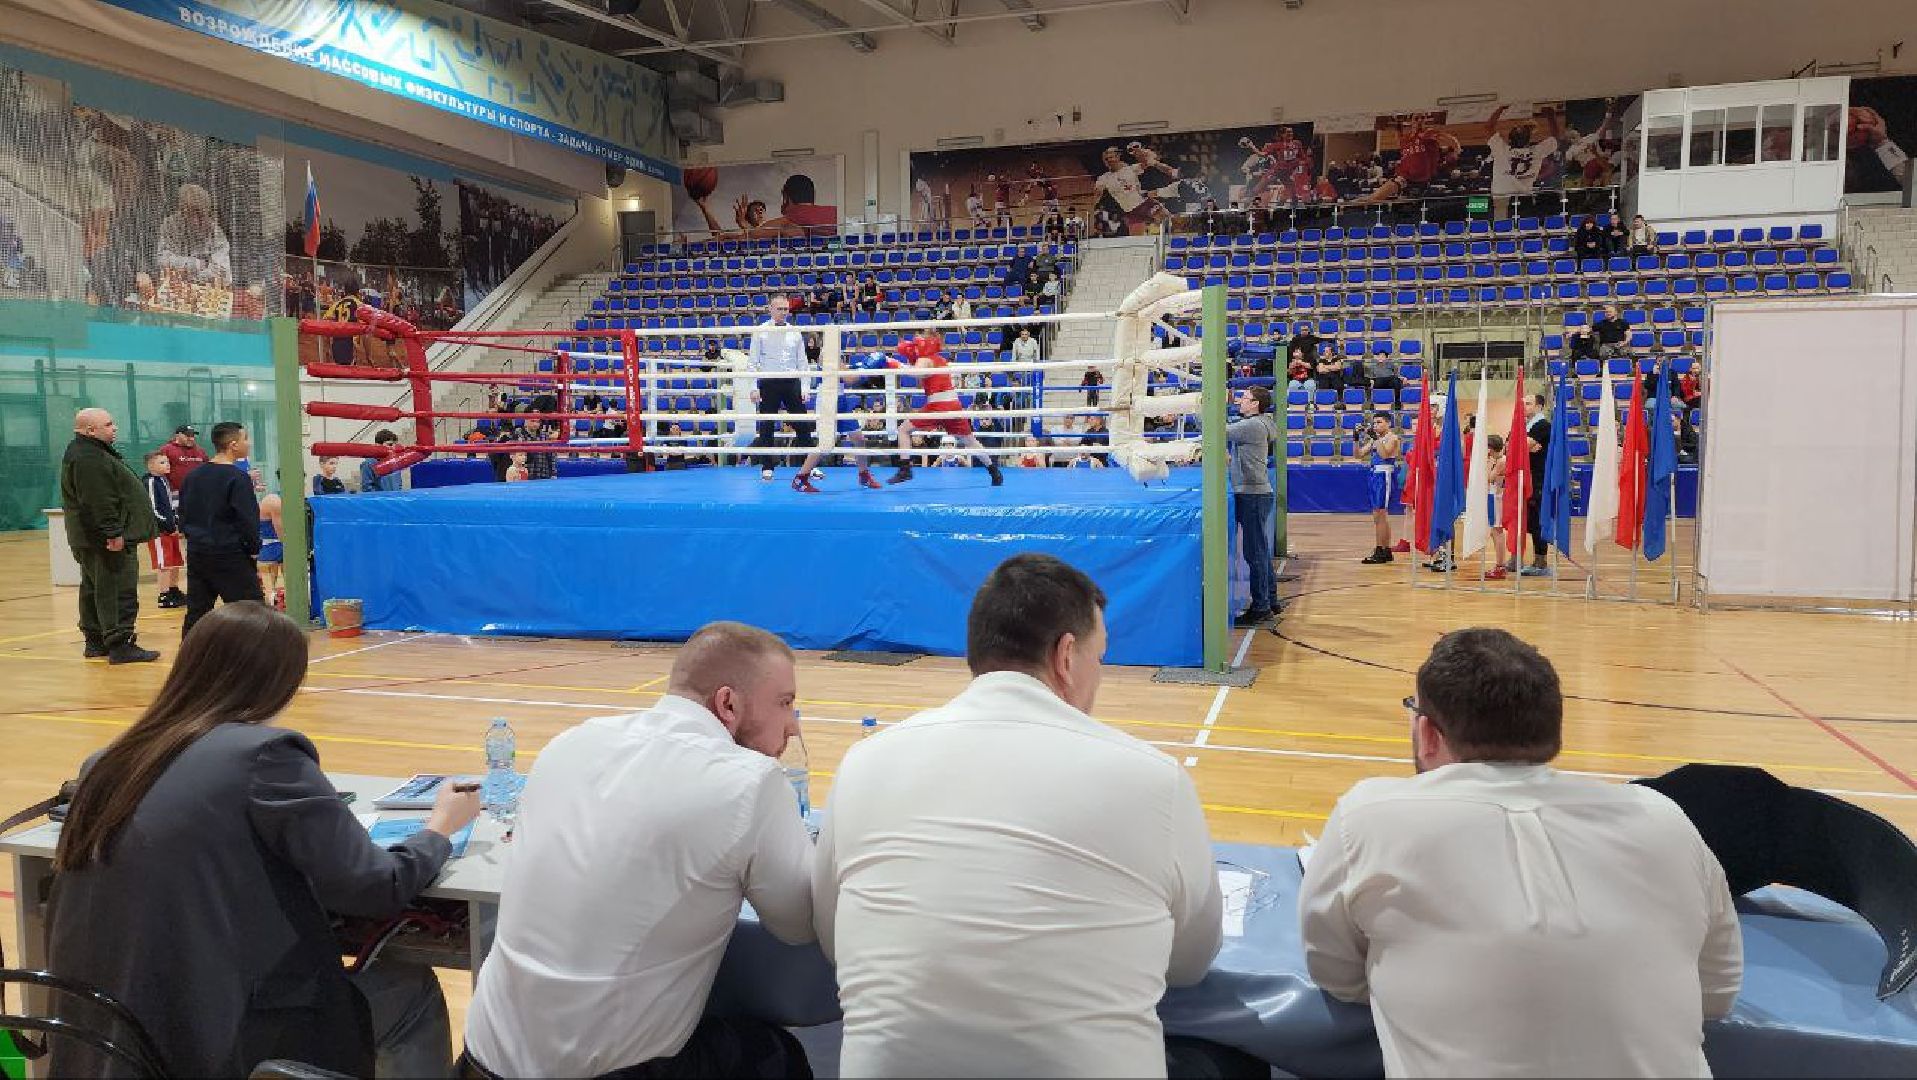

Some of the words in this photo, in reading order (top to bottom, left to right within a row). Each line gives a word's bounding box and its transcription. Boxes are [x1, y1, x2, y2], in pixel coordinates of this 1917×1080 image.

[406, 82, 495, 121] ФИЗКУЛЬТУРЫ
[499, 112, 507, 125] И
[509, 115, 550, 138] СПОРТА
[557, 132, 594, 153] ЗАДАЧА
